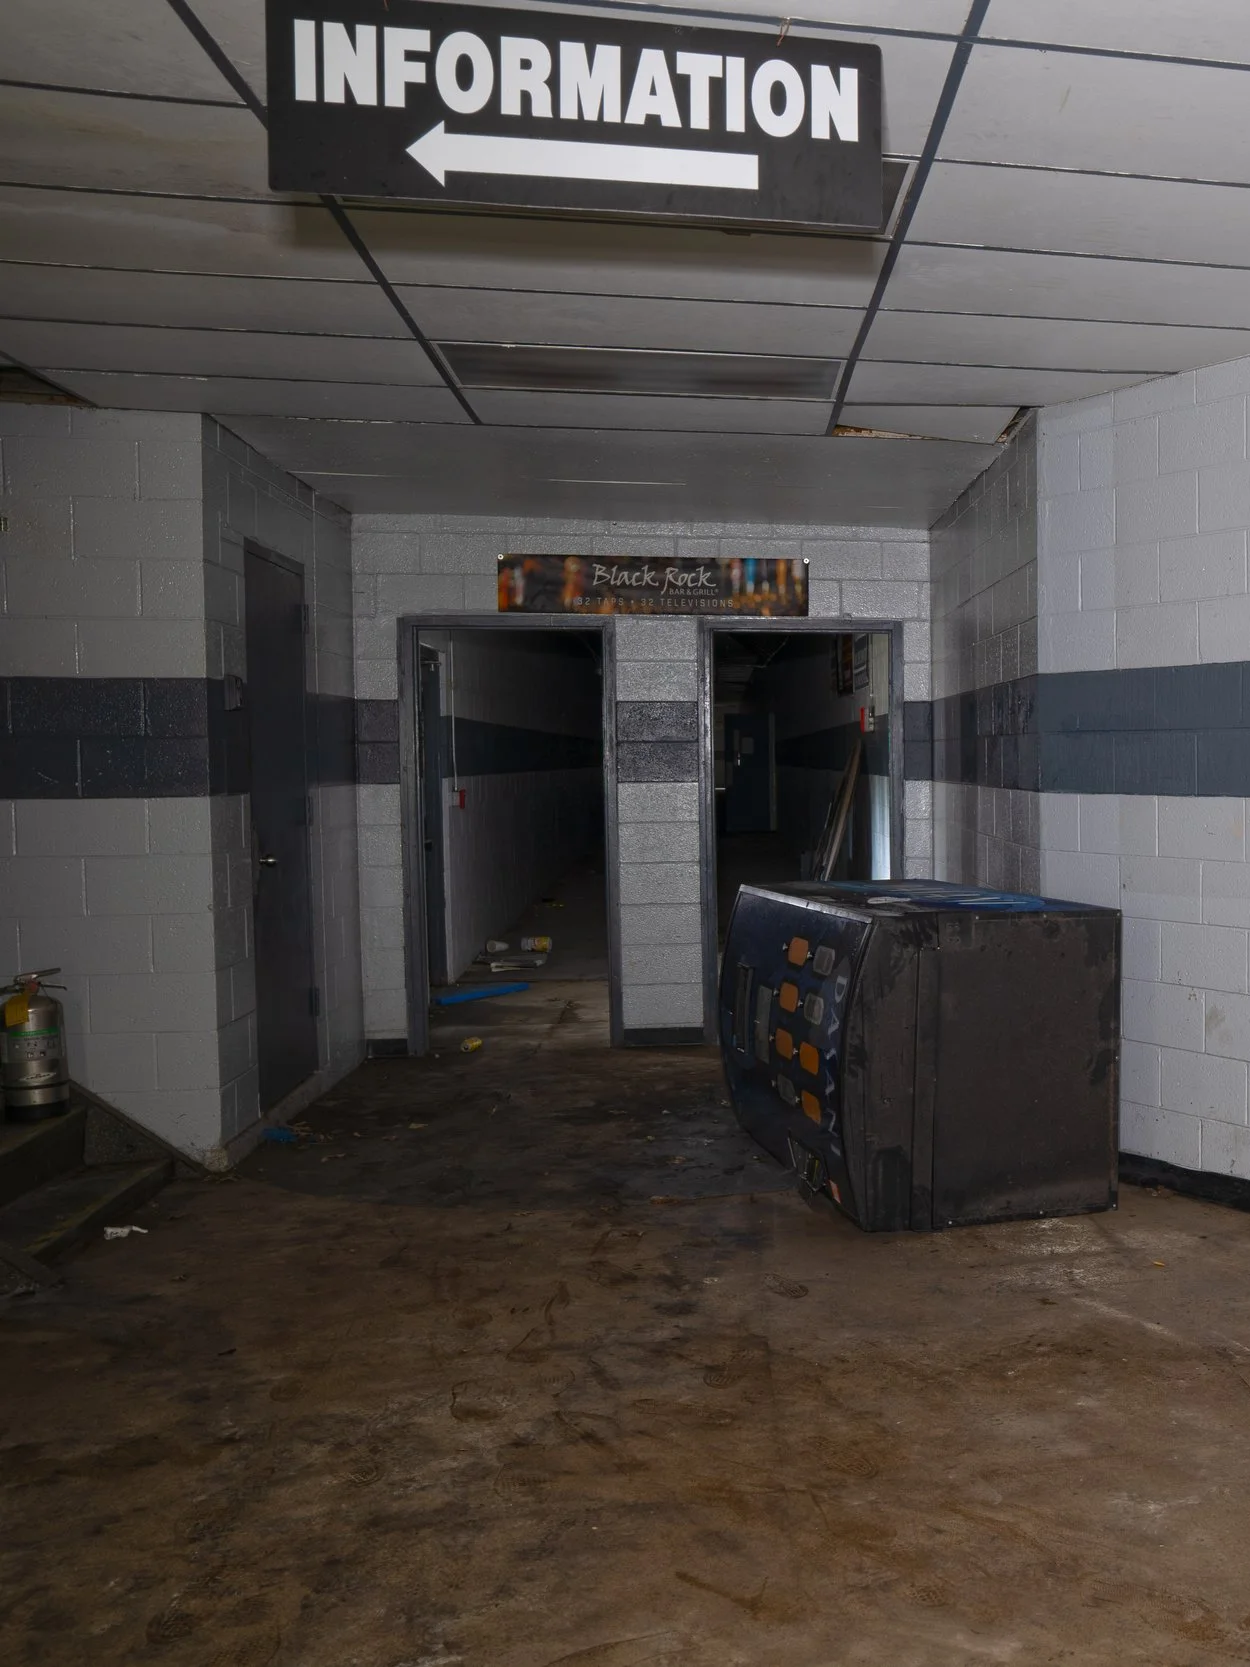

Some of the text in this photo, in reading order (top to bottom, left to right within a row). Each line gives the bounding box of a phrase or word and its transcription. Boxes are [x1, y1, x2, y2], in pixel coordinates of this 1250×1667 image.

[293, 18, 859, 142] INFORMATION
[592, 563, 718, 595] Black Rock
[577, 596, 734, 609] 32 TAPS 32 TELEVISIONS
[669, 588, 686, 596] BAR
[686, 588, 692, 596] &
